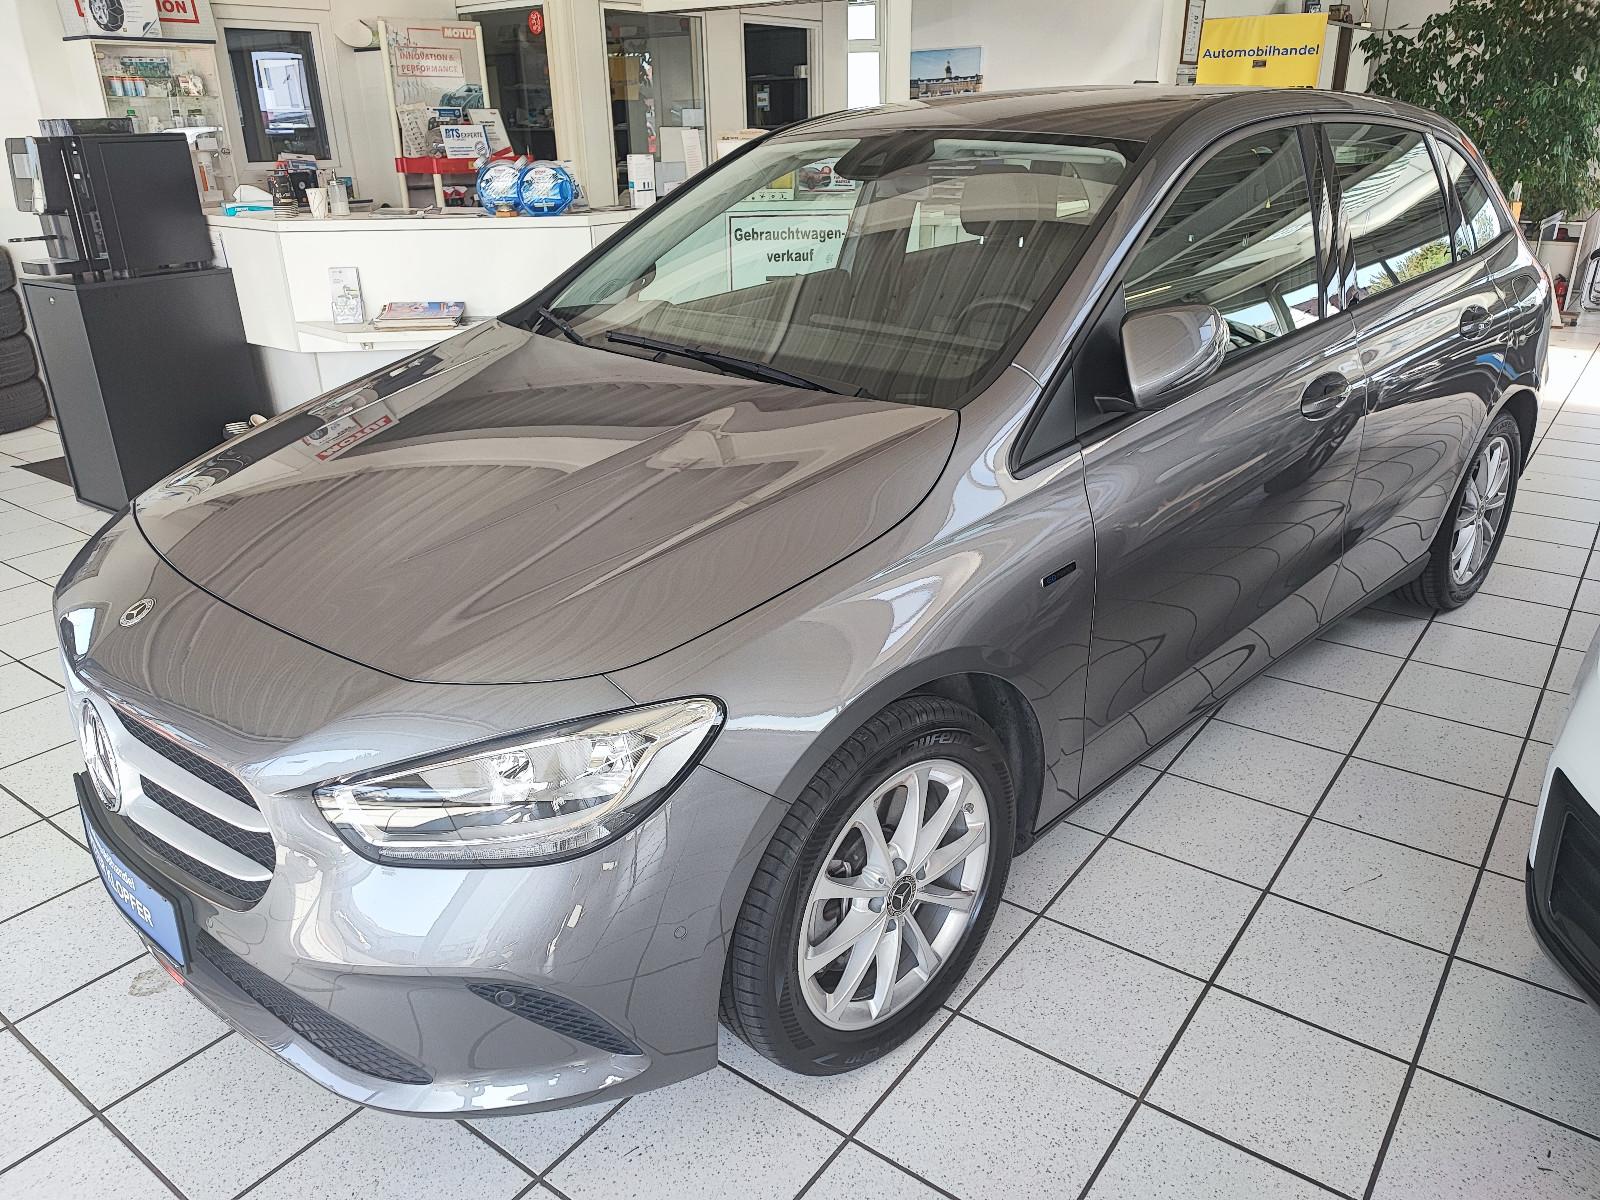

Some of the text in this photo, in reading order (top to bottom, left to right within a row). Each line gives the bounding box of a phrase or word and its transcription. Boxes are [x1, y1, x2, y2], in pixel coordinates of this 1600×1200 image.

[444, 28, 476, 38] MOTUL
[399, 51, 448, 61] INNOVATION
[1202, 44, 1320, 59] Automobilhandel
[401, 64, 459, 73] PERFORMANCE
[445, 128, 460, 138] BTS
[734, 227, 845, 243] Gebrauchtwagen-
[767, 248, 815, 262] verkauf
